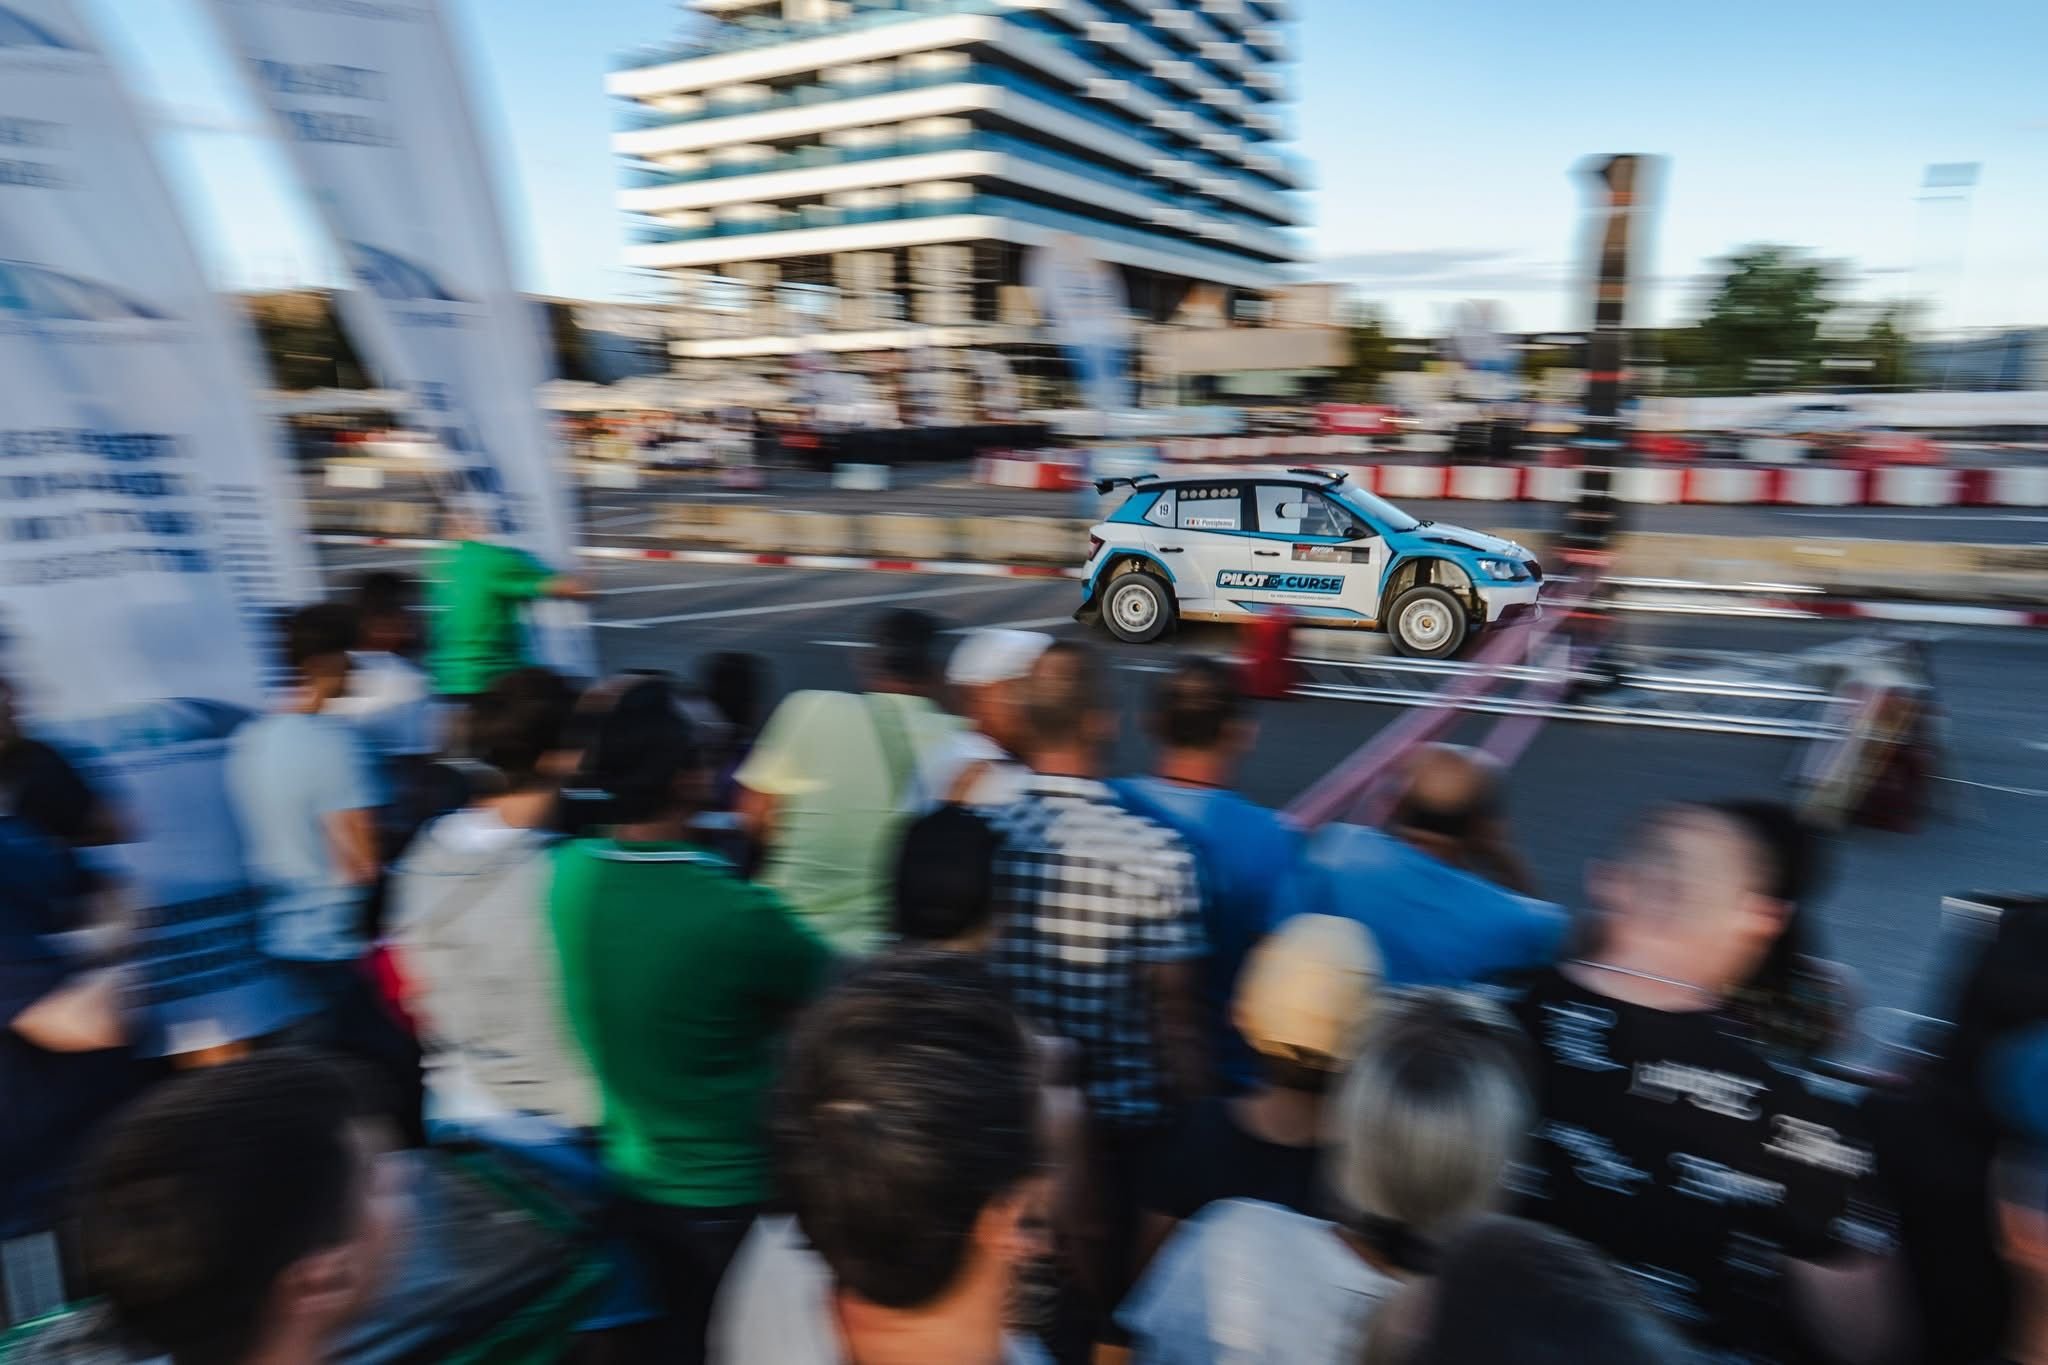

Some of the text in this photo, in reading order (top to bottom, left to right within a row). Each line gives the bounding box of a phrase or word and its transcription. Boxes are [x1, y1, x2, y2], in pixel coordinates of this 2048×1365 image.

[1159, 504, 1169, 516] 19
[1219, 572, 1268, 587] PILOT
[1286, 576, 1340, 590] CURSE
